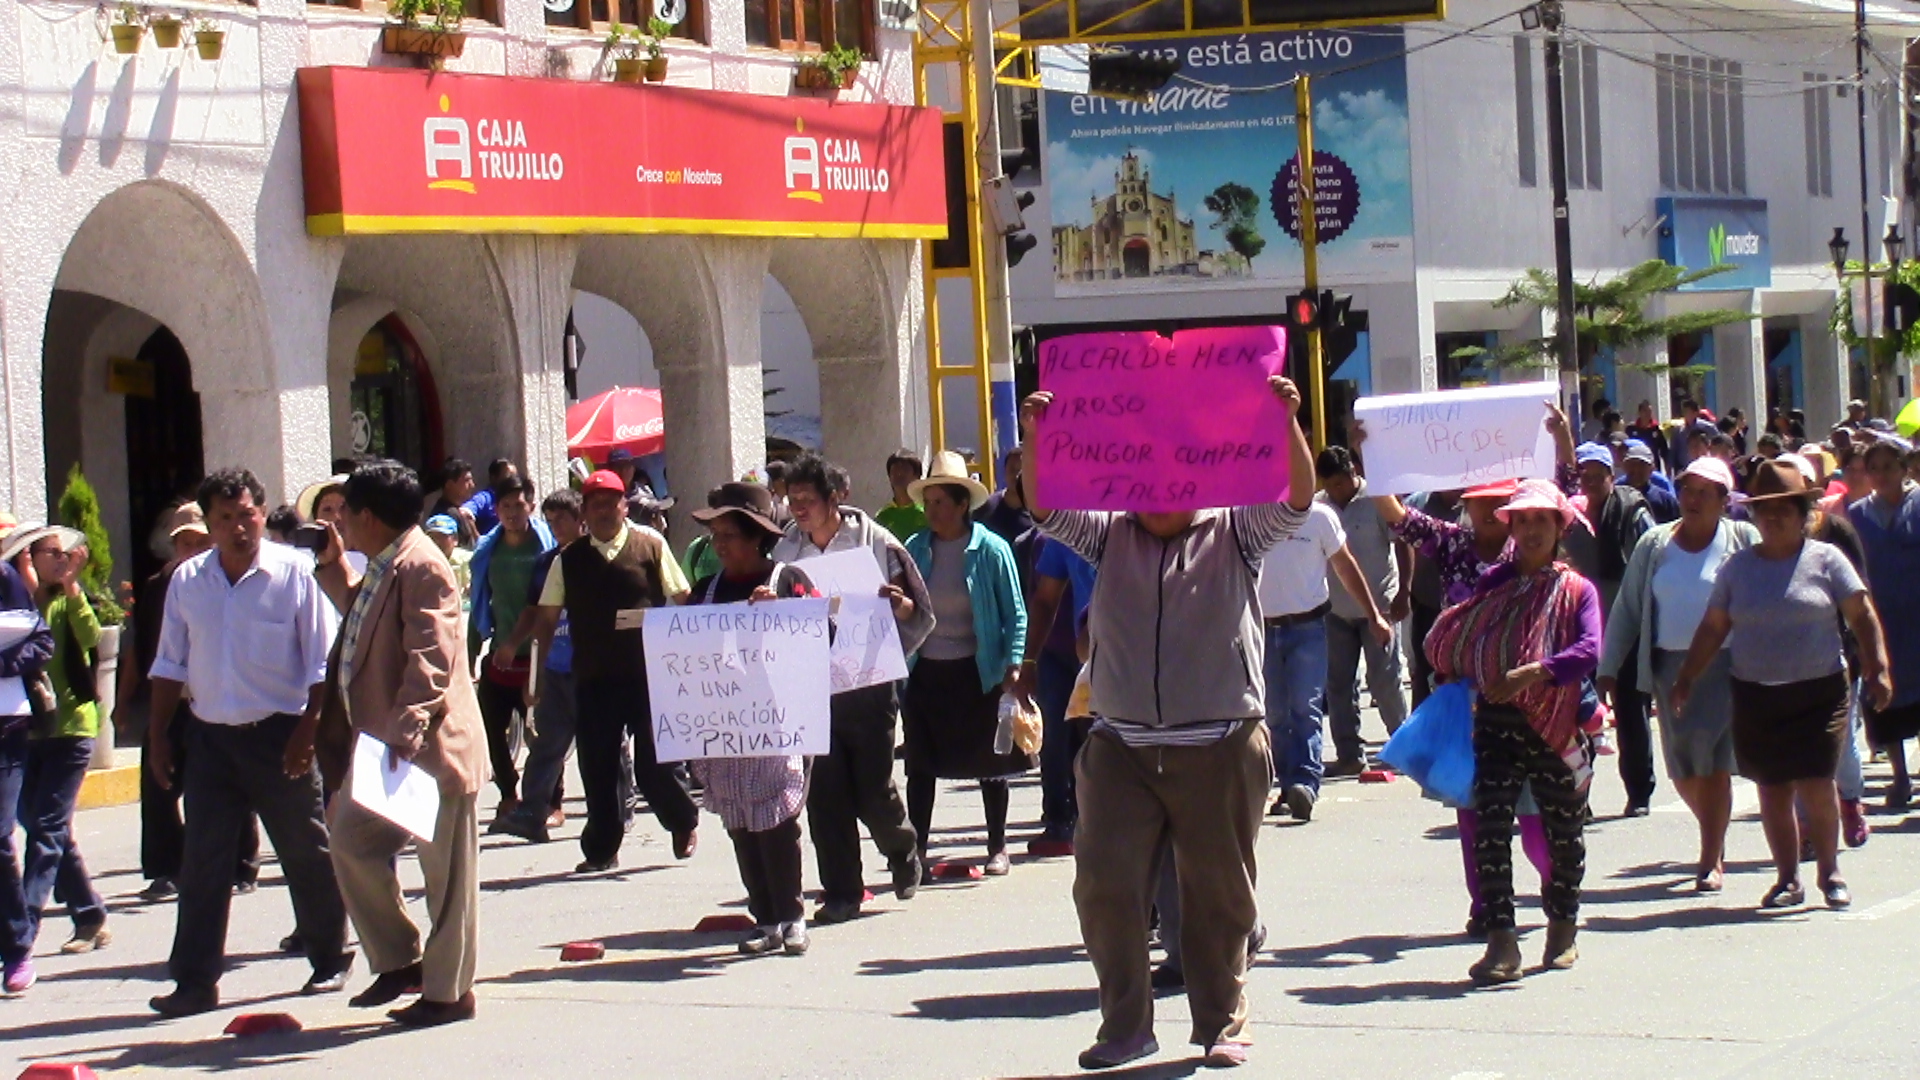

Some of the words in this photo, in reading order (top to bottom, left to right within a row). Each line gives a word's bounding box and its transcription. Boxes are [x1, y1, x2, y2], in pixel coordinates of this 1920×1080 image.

[1187, 33, 1252, 67] está
[1260, 31, 1353, 63] activo
[477, 118, 527, 148] CAJA
[1070, 127, 1099, 139] Ahora
[1134, 123, 1173, 136] Navegar
[1247, 118, 1259, 127] en
[1276, 115, 1295, 126] LTE
[824, 138, 861, 164] CAJA
[479, 151, 564, 180] TRUJILLO
[636, 165, 663, 182] Crece
[665, 171, 681, 184] con
[683, 167, 722, 186] Nosotros
[825, 166, 889, 192] TRUJILLO
[1315, 176, 1341, 188] bono
[1319, 218, 1341, 230] plan
[1043, 344, 1177, 378] ALCALDE
[1045, 431, 1152, 463] PONGOR
[1175, 443, 1274, 466] COMPRA
[1090, 474, 1198, 501] FALSA
[667, 608, 824, 638] AUTORIDADES
[661, 648, 777, 676] RESPETEN
[678, 682, 688, 697] A
[702, 680, 743, 699] UNA
